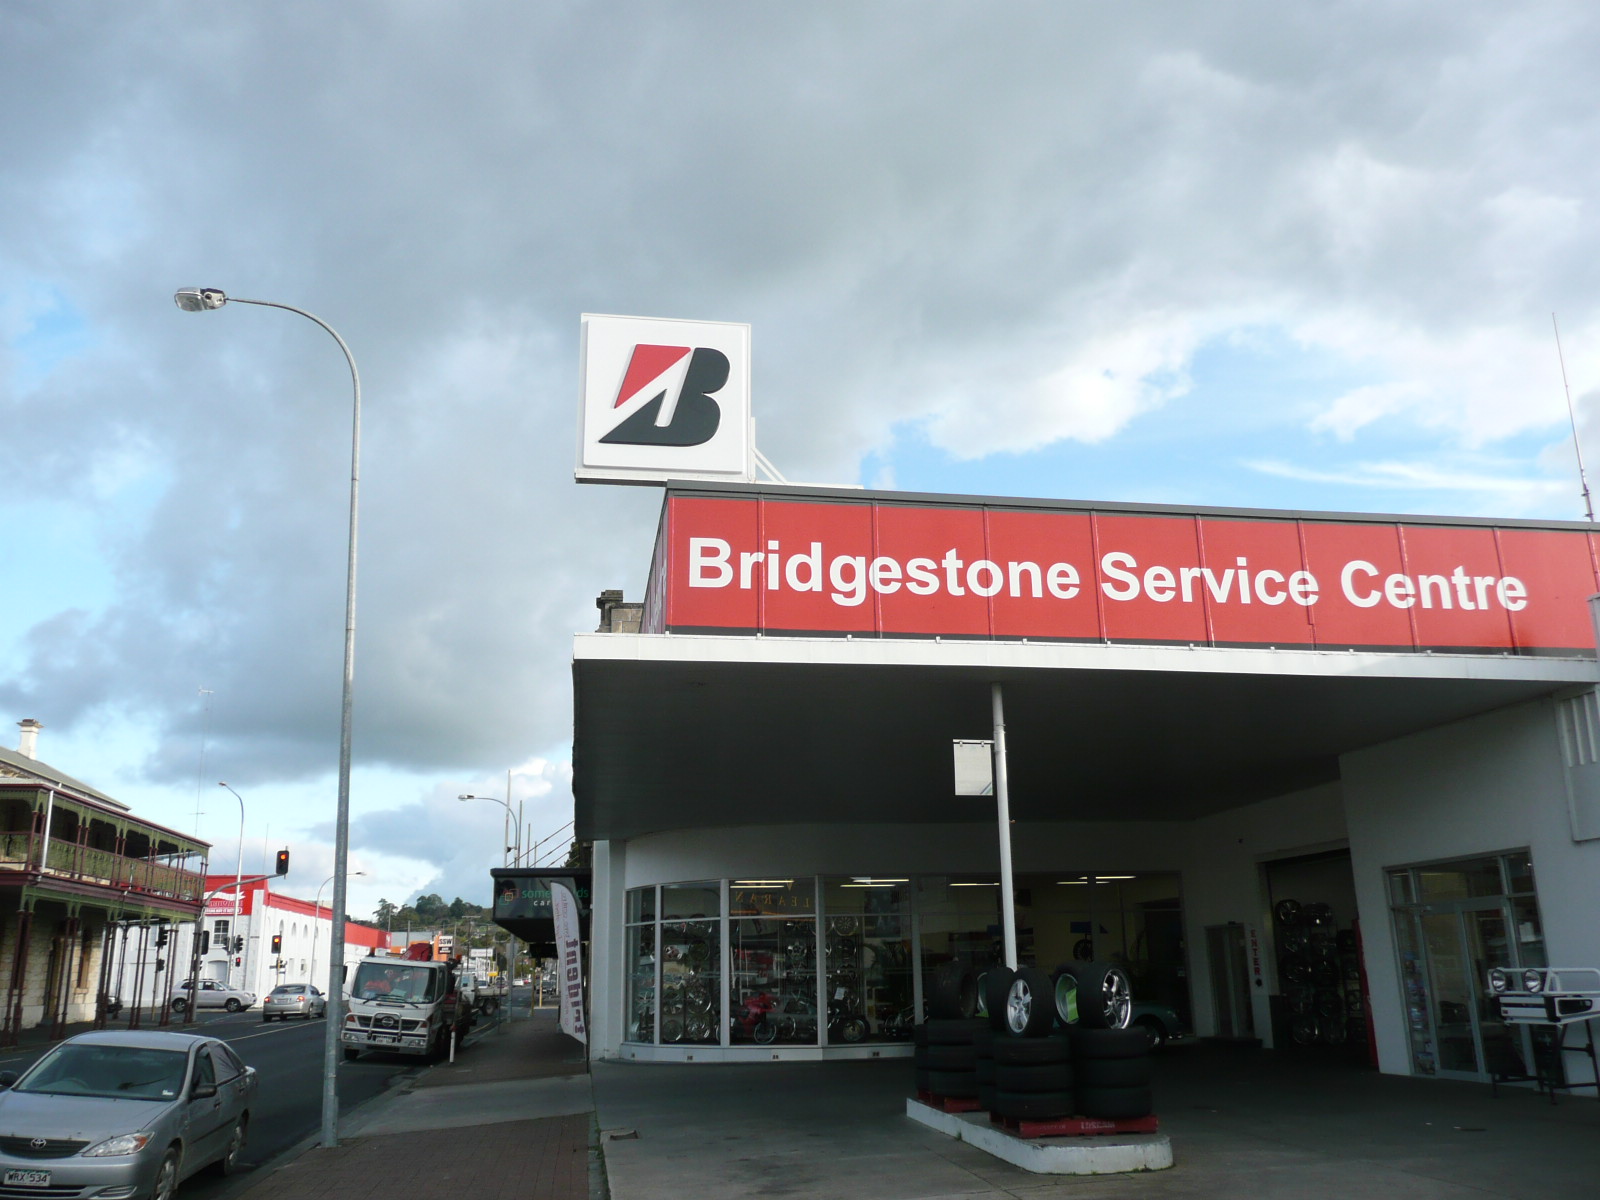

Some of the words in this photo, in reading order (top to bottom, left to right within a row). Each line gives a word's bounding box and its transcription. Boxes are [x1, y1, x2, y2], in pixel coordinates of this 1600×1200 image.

[688, 536, 1080, 607] Bridgestone
[1100, 551, 1319, 606] Service
[1340, 559, 1528, 612] Centre
[1250, 928, 1261, 975] ENTER
[8, 1172, 25, 1182] WRX
[29, 1173, 48, 1183] 534
